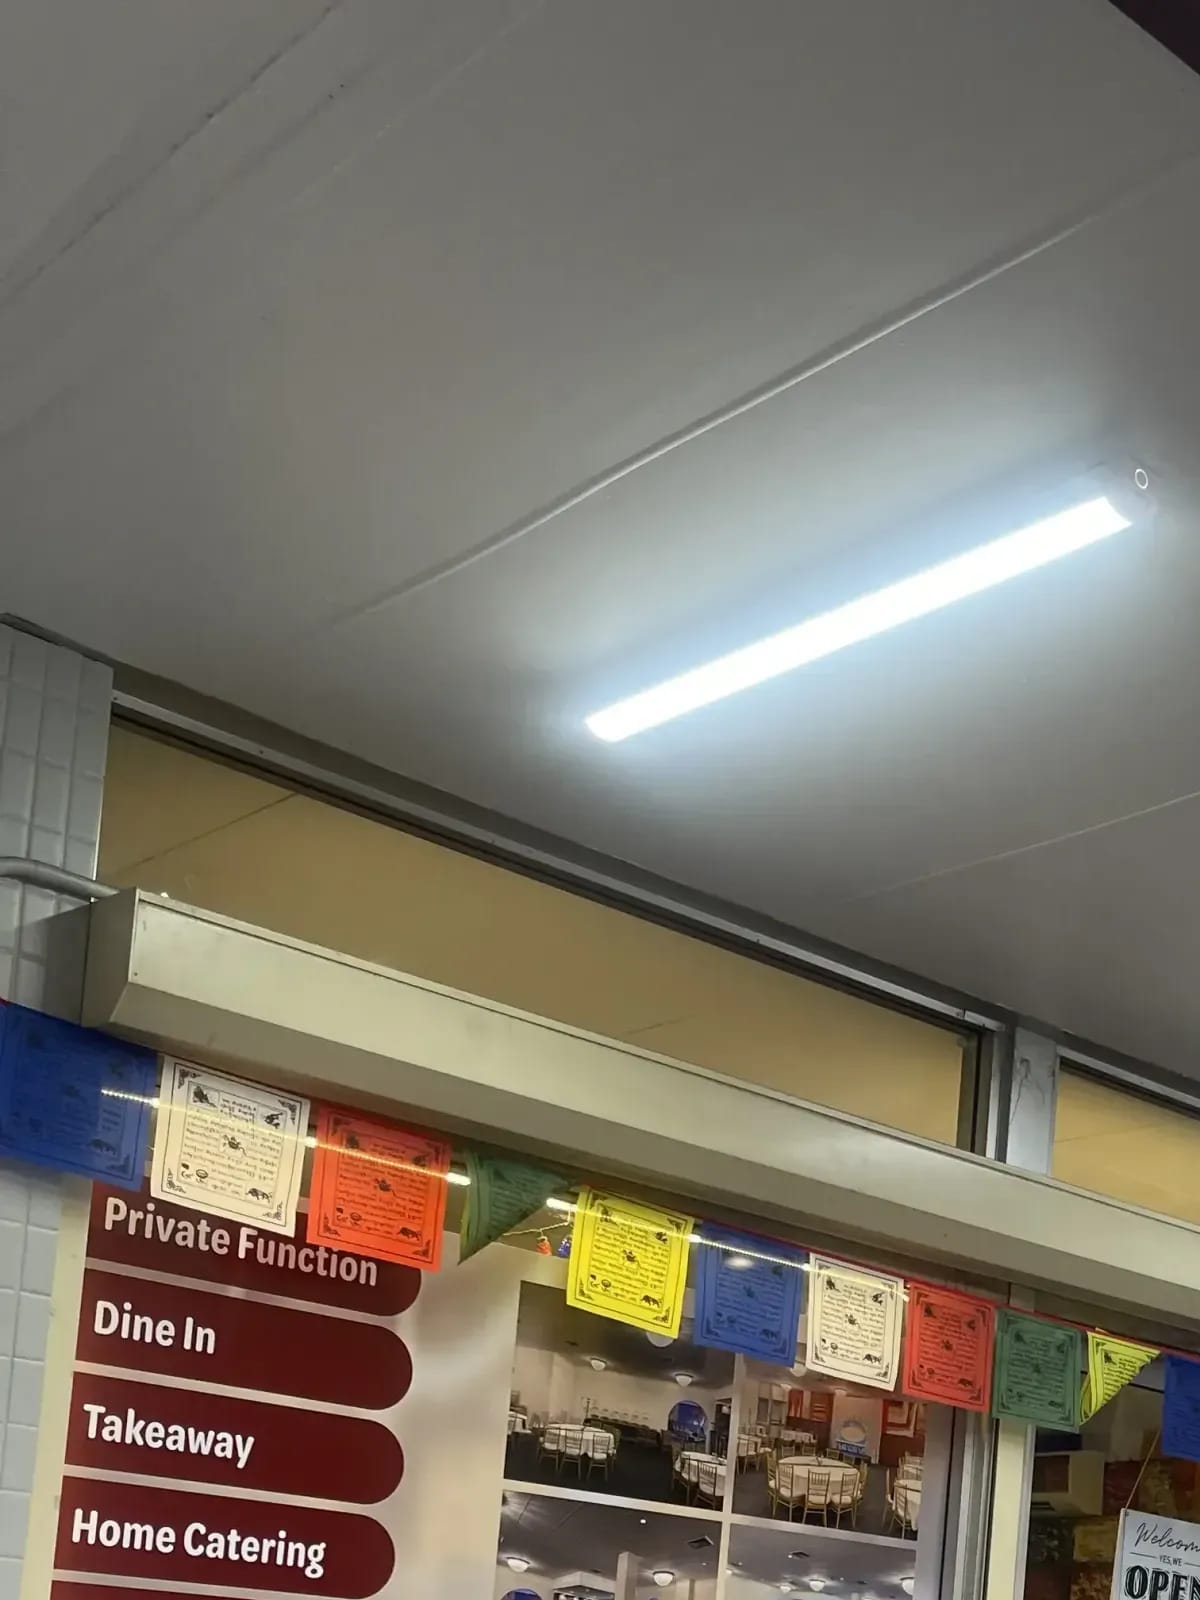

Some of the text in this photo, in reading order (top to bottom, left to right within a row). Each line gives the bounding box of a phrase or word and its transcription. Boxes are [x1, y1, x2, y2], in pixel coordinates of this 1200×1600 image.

[104, 1197, 378, 1286] Private Function
[94, 1300, 216, 1354] Dine In
[83, 1404, 255, 1469] Takeaway
[72, 1508, 327, 1578] Home Catering
